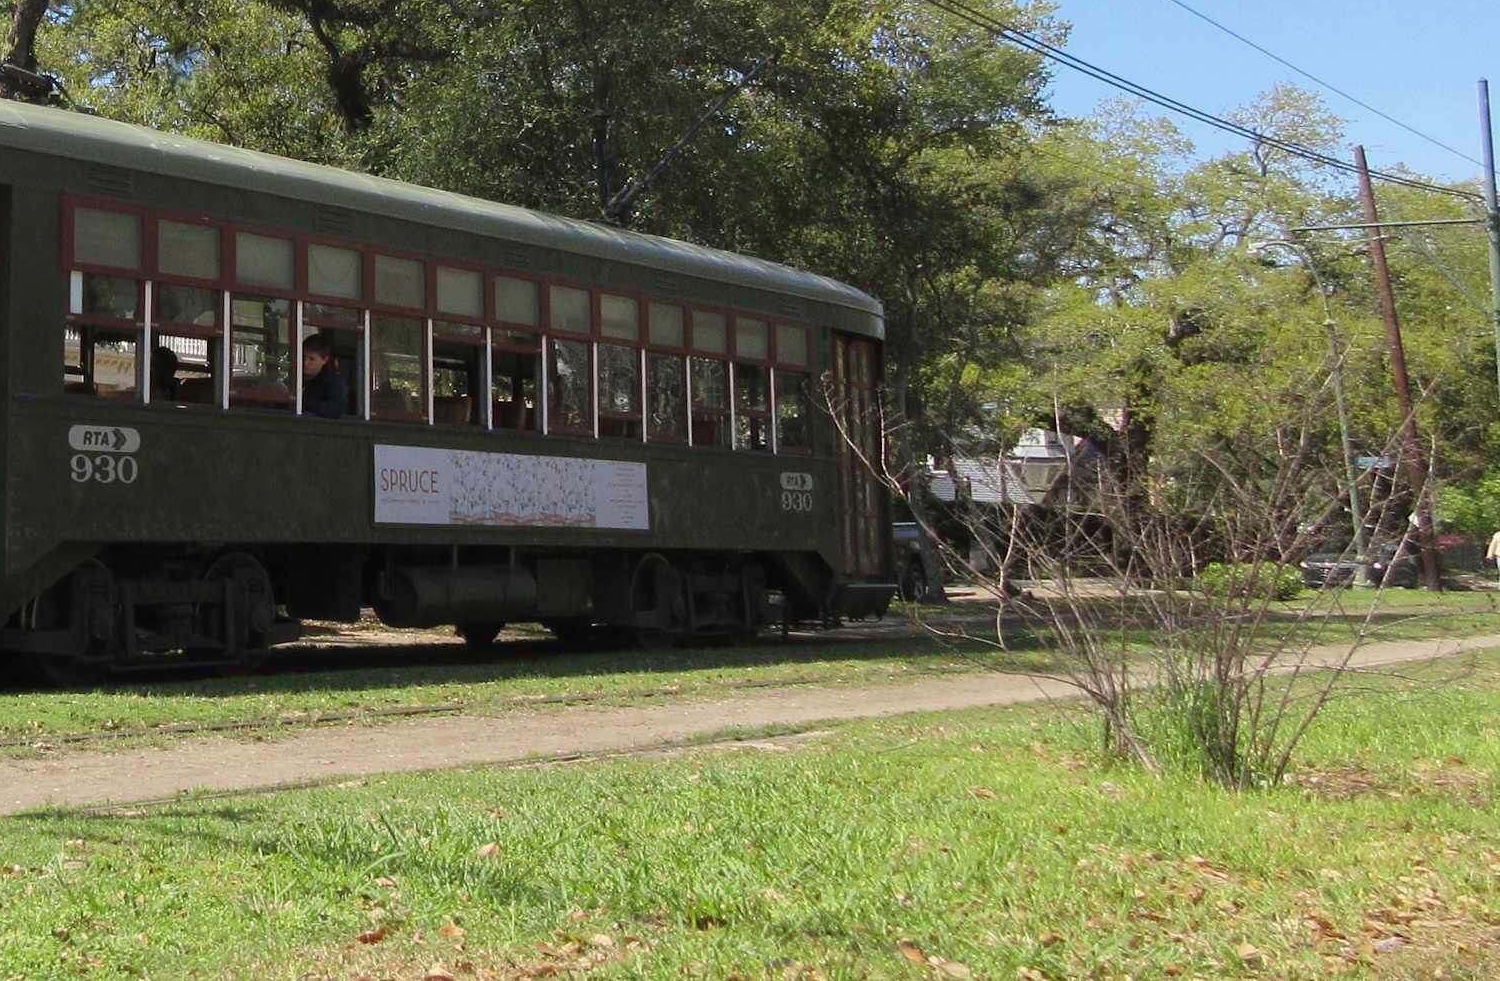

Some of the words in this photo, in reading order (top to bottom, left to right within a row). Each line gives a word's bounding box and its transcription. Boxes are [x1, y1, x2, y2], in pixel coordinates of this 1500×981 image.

[83, 430, 110, 446] RTA
[70, 454, 139, 484] 930
[380, 468, 439, 495] SPRUCE
[781, 491, 813, 512] 930
